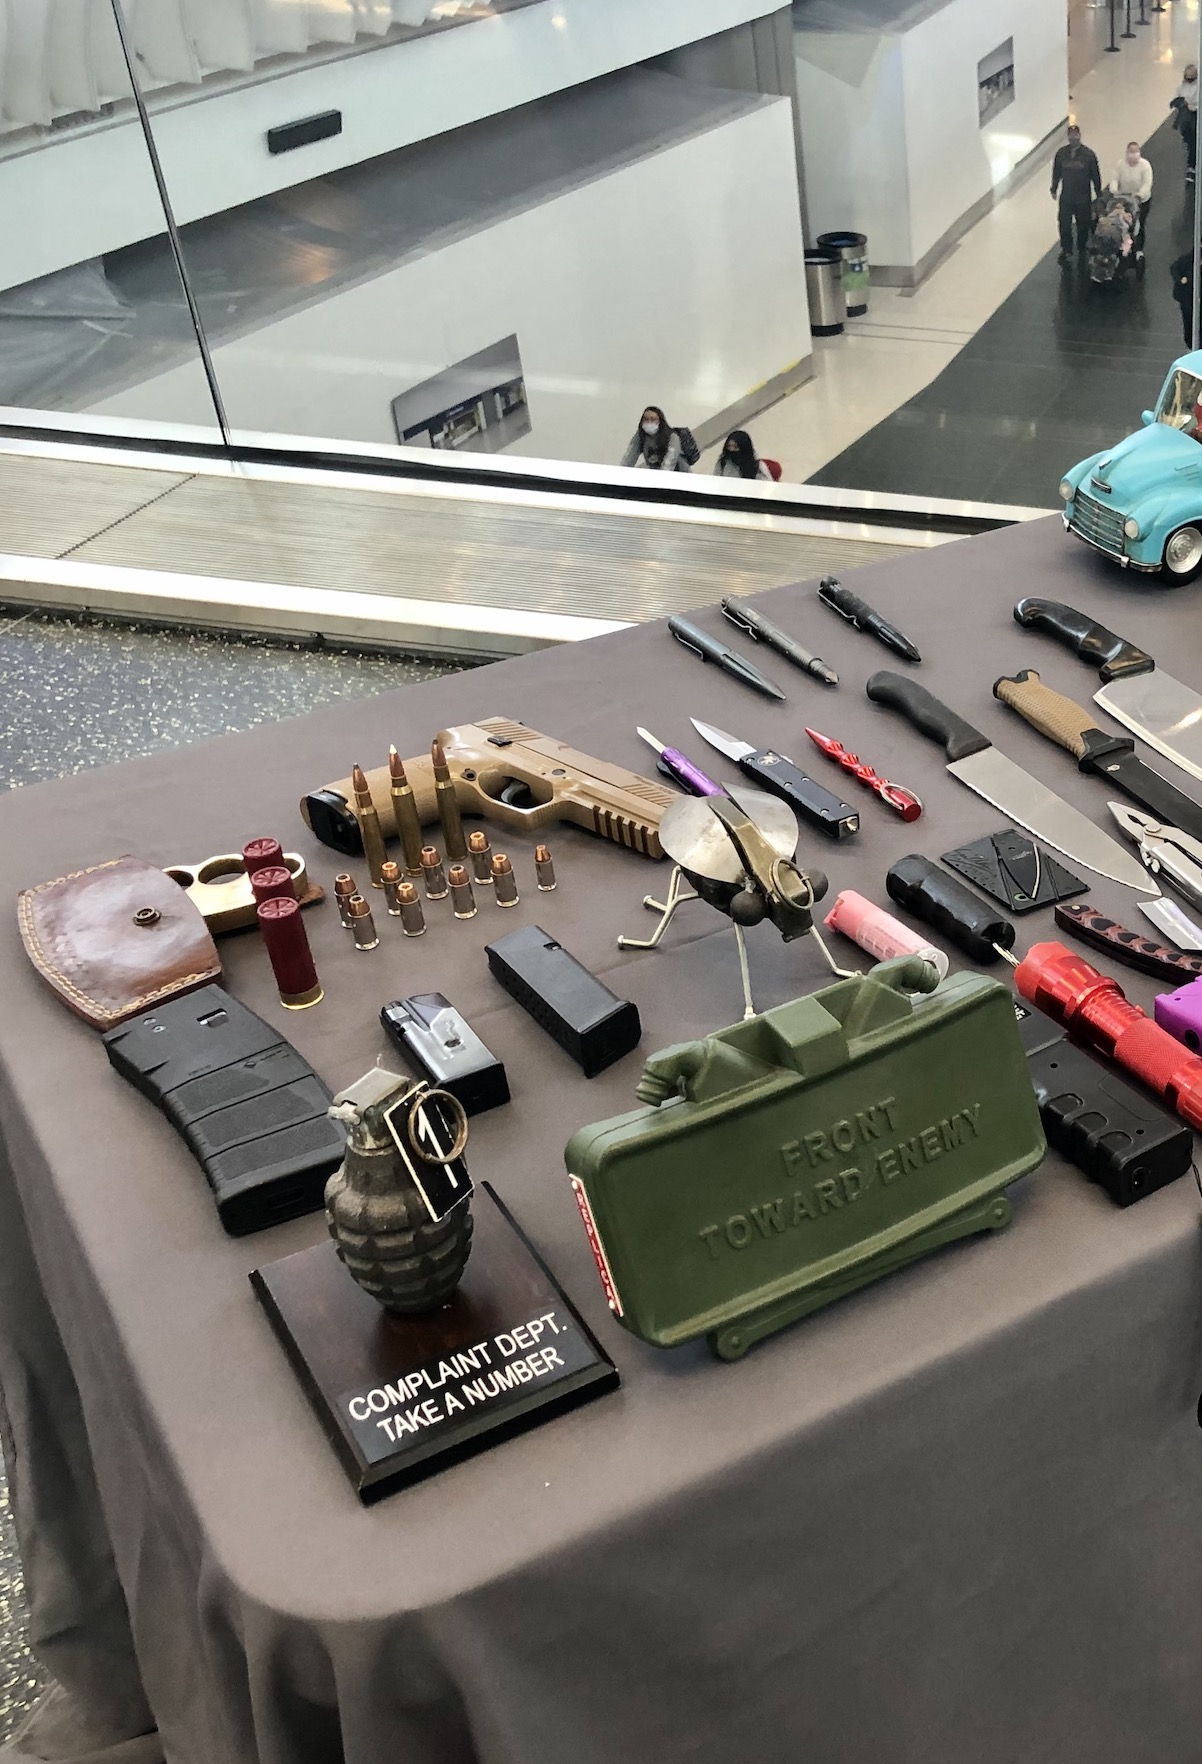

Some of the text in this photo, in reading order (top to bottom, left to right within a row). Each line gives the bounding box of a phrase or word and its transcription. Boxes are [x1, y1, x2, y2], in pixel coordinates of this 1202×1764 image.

[699, 1103, 981, 1260] TOWARD ENEMY
[780, 1096, 896, 1177] FRONT
[348, 1312, 568, 1421] COMPLAINT DEPT.
[376, 1346, 565, 1442] TAKE A NUMBER
